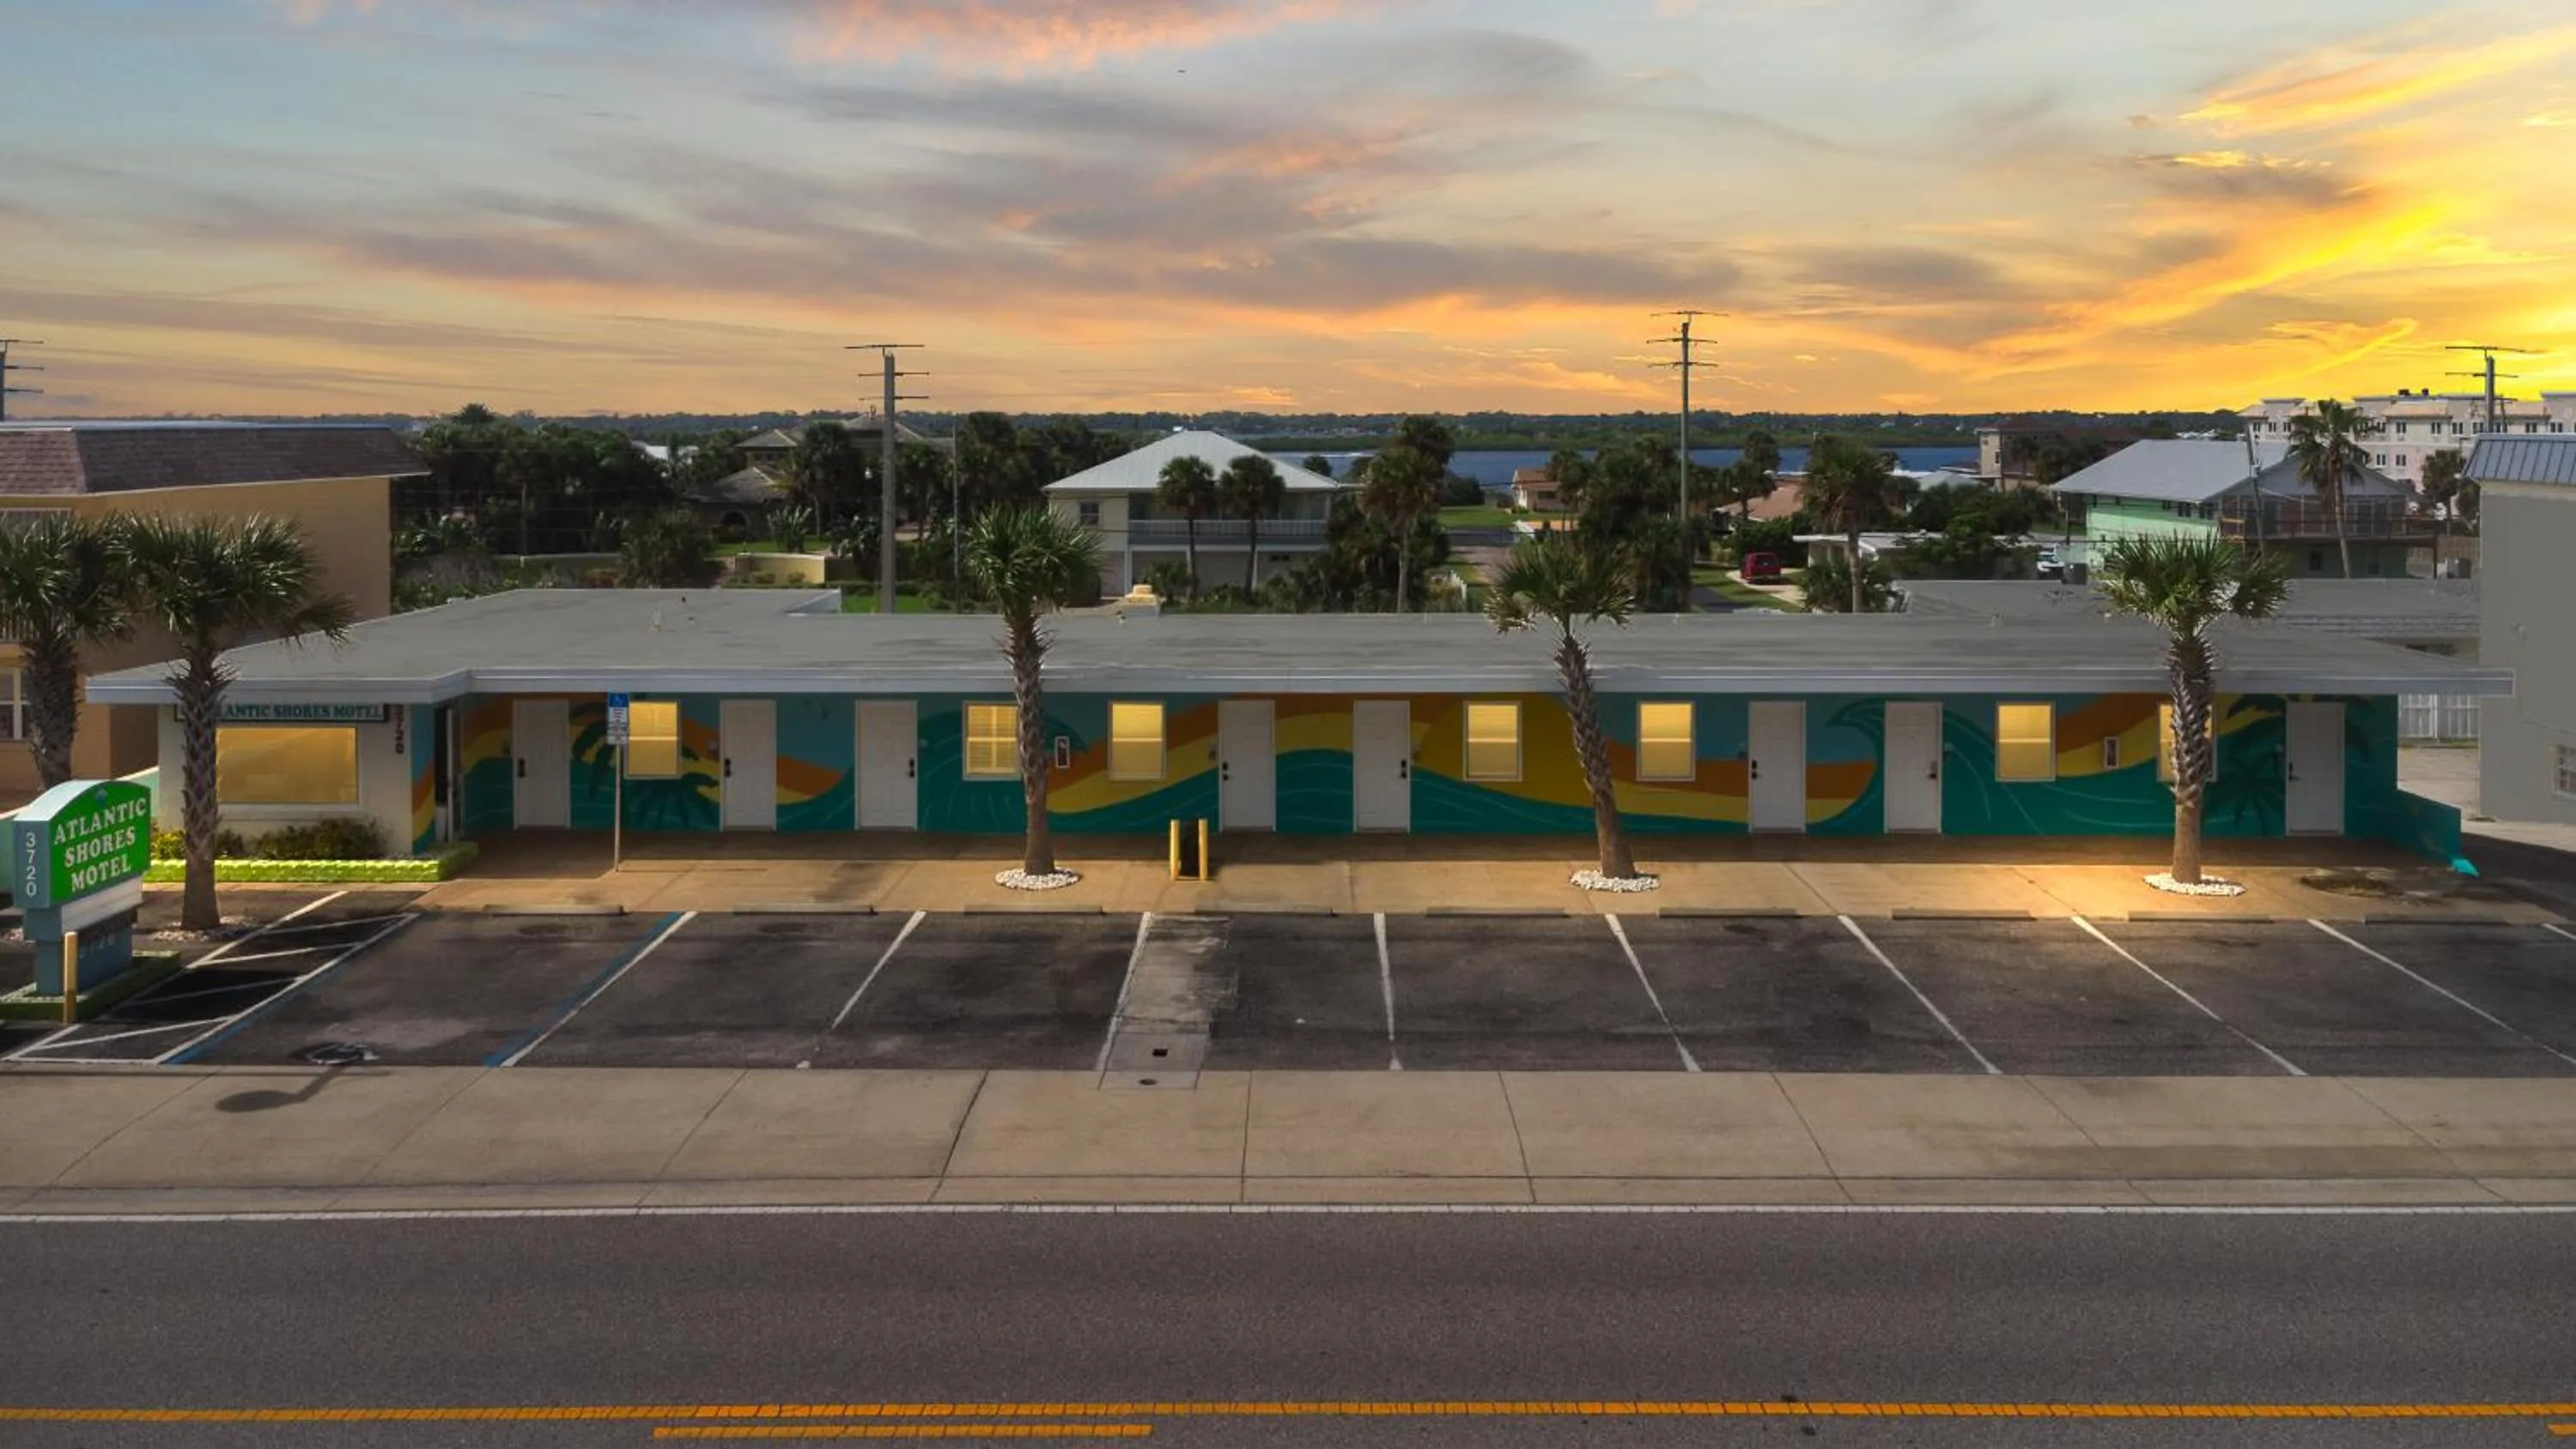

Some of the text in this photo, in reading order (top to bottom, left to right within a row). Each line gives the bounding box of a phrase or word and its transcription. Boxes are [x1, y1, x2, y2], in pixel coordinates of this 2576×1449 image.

[216, 703, 382, 718] LANTIC SHORES MOTEL
[54, 797, 147, 846] ATLANTIC
[26, 832, 37, 898] 3720
[64, 826, 136, 868] SHORES
[70, 853, 131, 893] MOTEL
